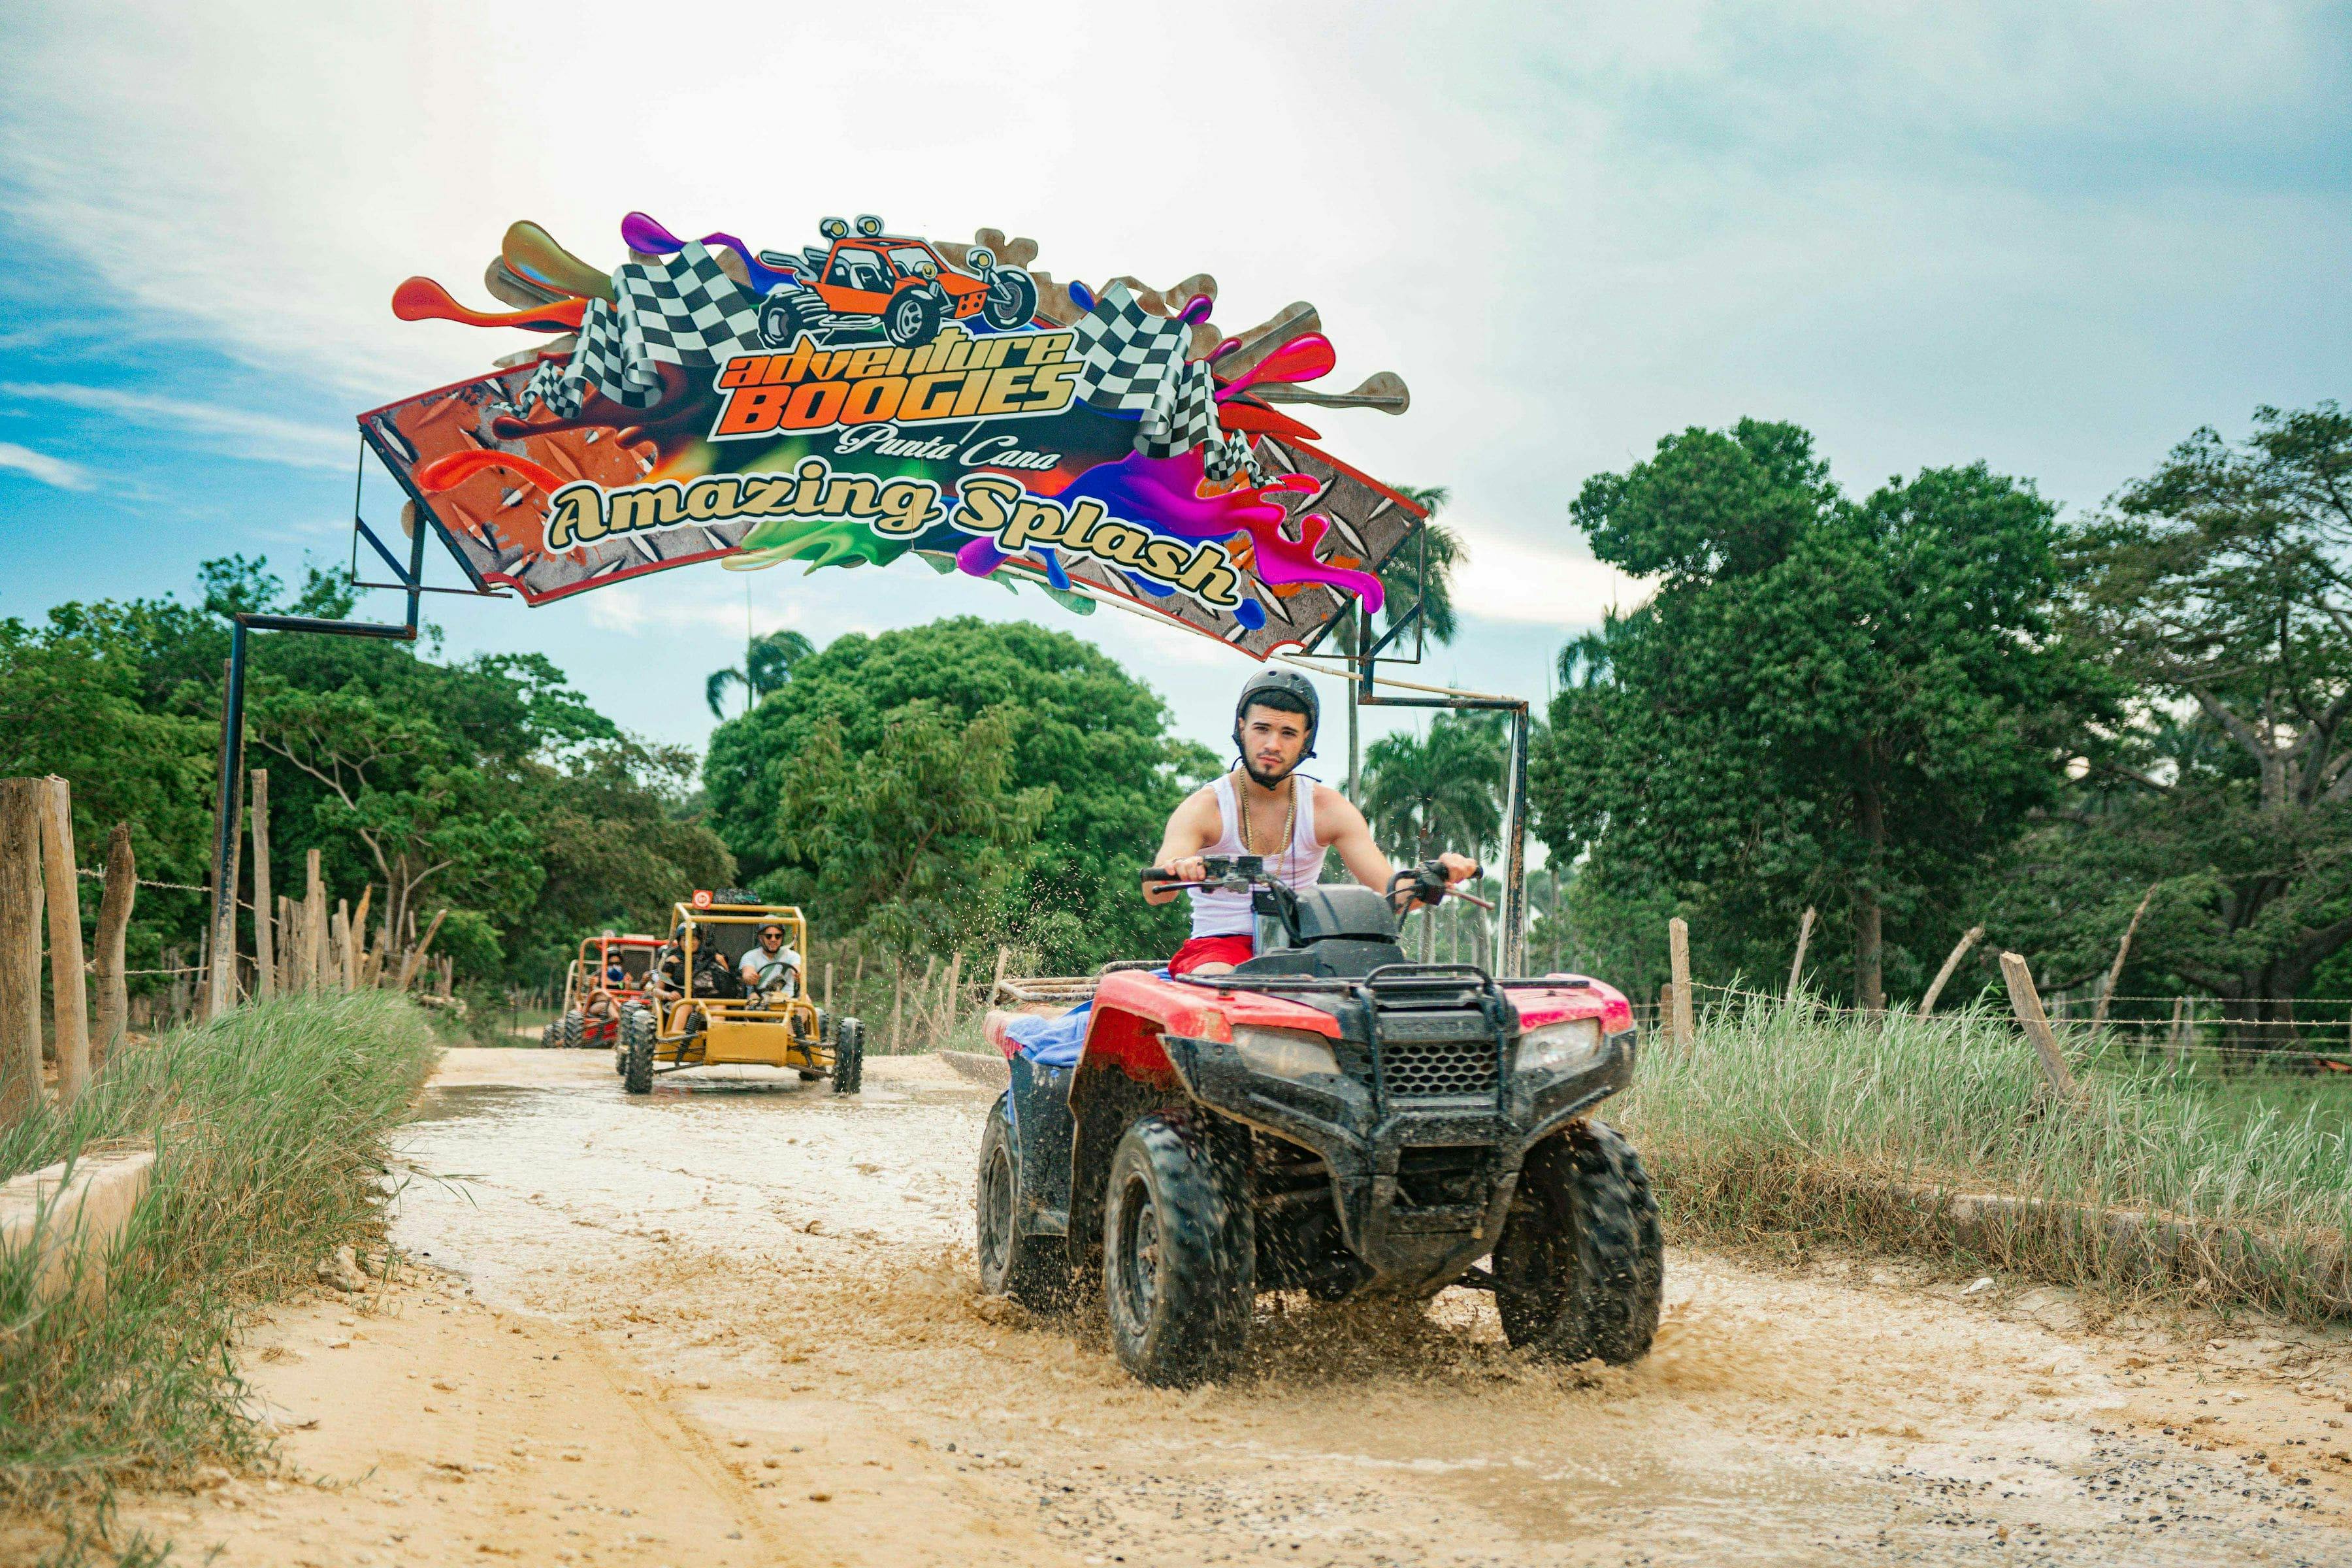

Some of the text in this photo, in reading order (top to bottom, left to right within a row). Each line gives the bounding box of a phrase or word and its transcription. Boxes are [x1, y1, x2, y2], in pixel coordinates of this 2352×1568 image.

[718, 326, 1075, 389] adventure
[716, 361, 1085, 436] BOOGIES
[834, 422, 1062, 470] Punta Cana
[547, 459, 1239, 606] Amazing Splash
